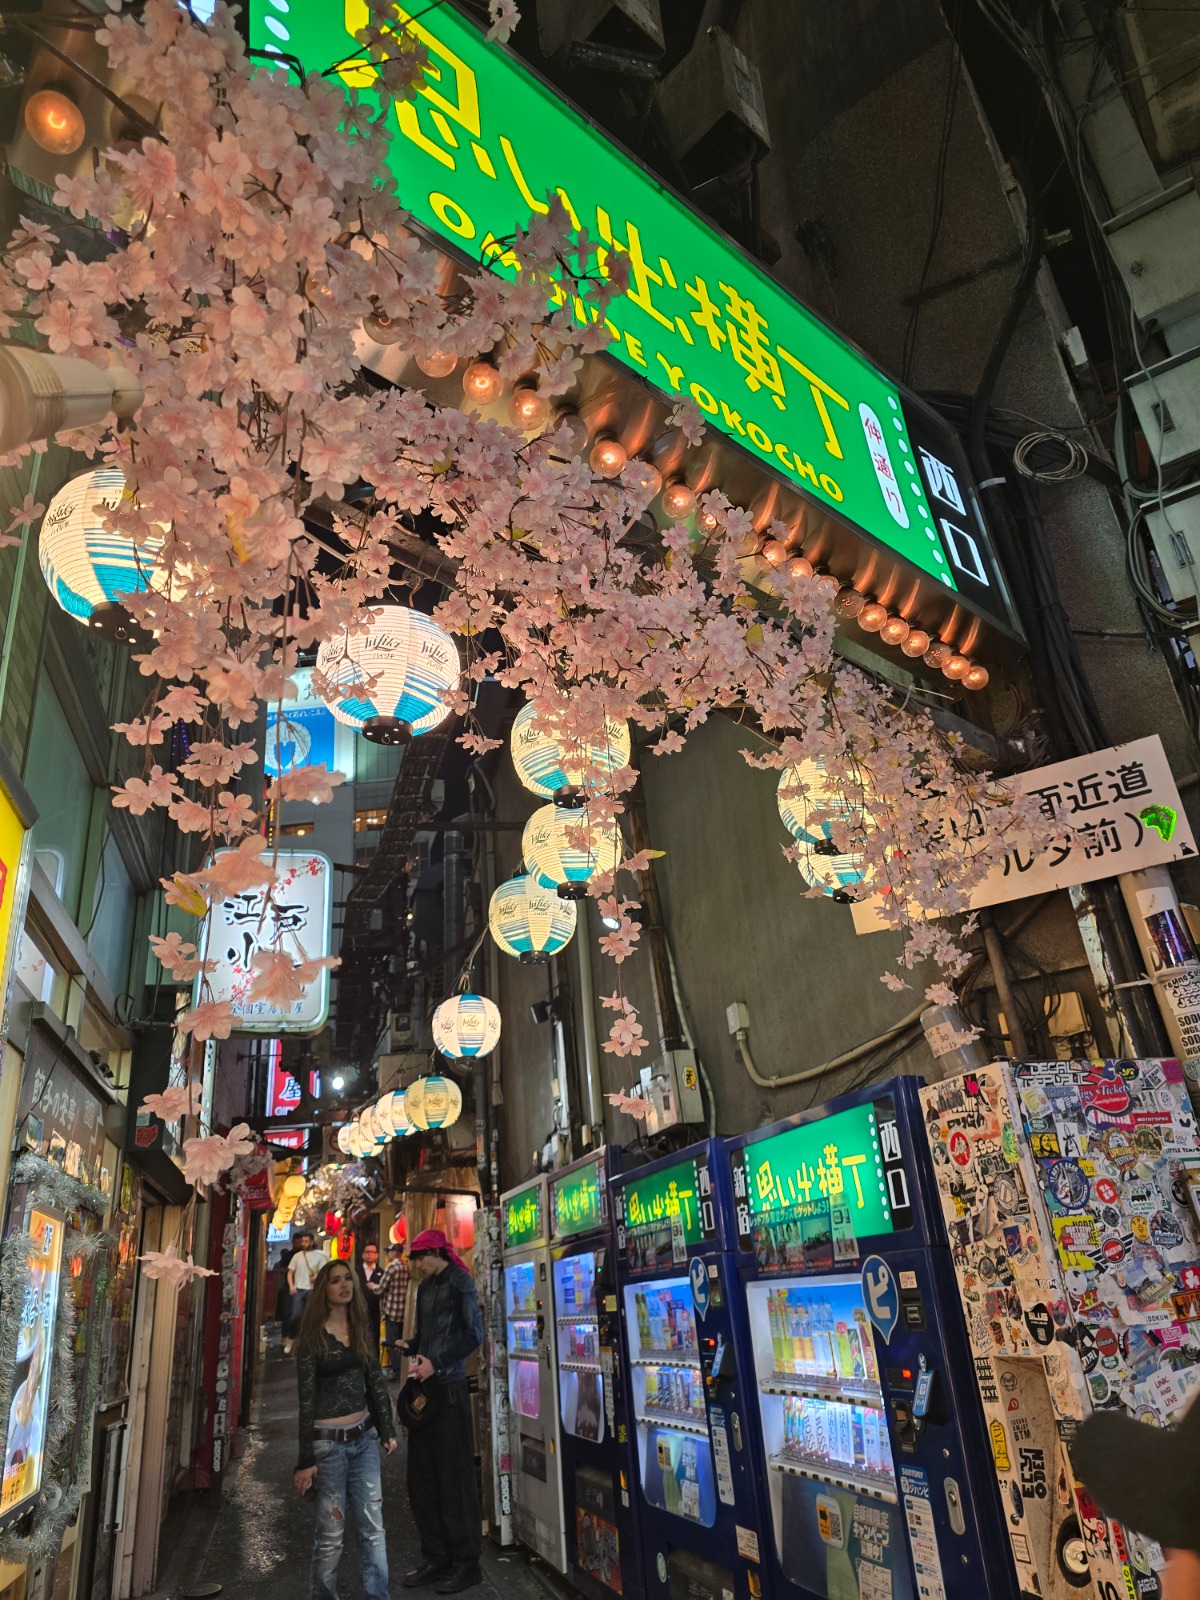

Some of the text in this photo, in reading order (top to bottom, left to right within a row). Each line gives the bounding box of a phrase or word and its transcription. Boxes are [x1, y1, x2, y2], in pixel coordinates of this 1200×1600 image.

[655, 350, 845, 504] YOKOCHO
[863, 416, 905, 517] 仲通り
[918, 445, 991, 588] 西口
[1101, 1083, 1131, 1096] Tickets
[879, 1119, 911, 1210] 西口
[733, 1165, 751, 1236] 新宿
[1154, 1376, 1170, 1389] LINK
[1160, 1386, 1172, 1397] AND
[1164, 1393, 1179, 1407] LIVE
[1013, 1429, 1032, 1441] BTM
[902, 1467, 924, 1479] SUNTORY
[853, 1521, 890, 1547] キャンペーン
